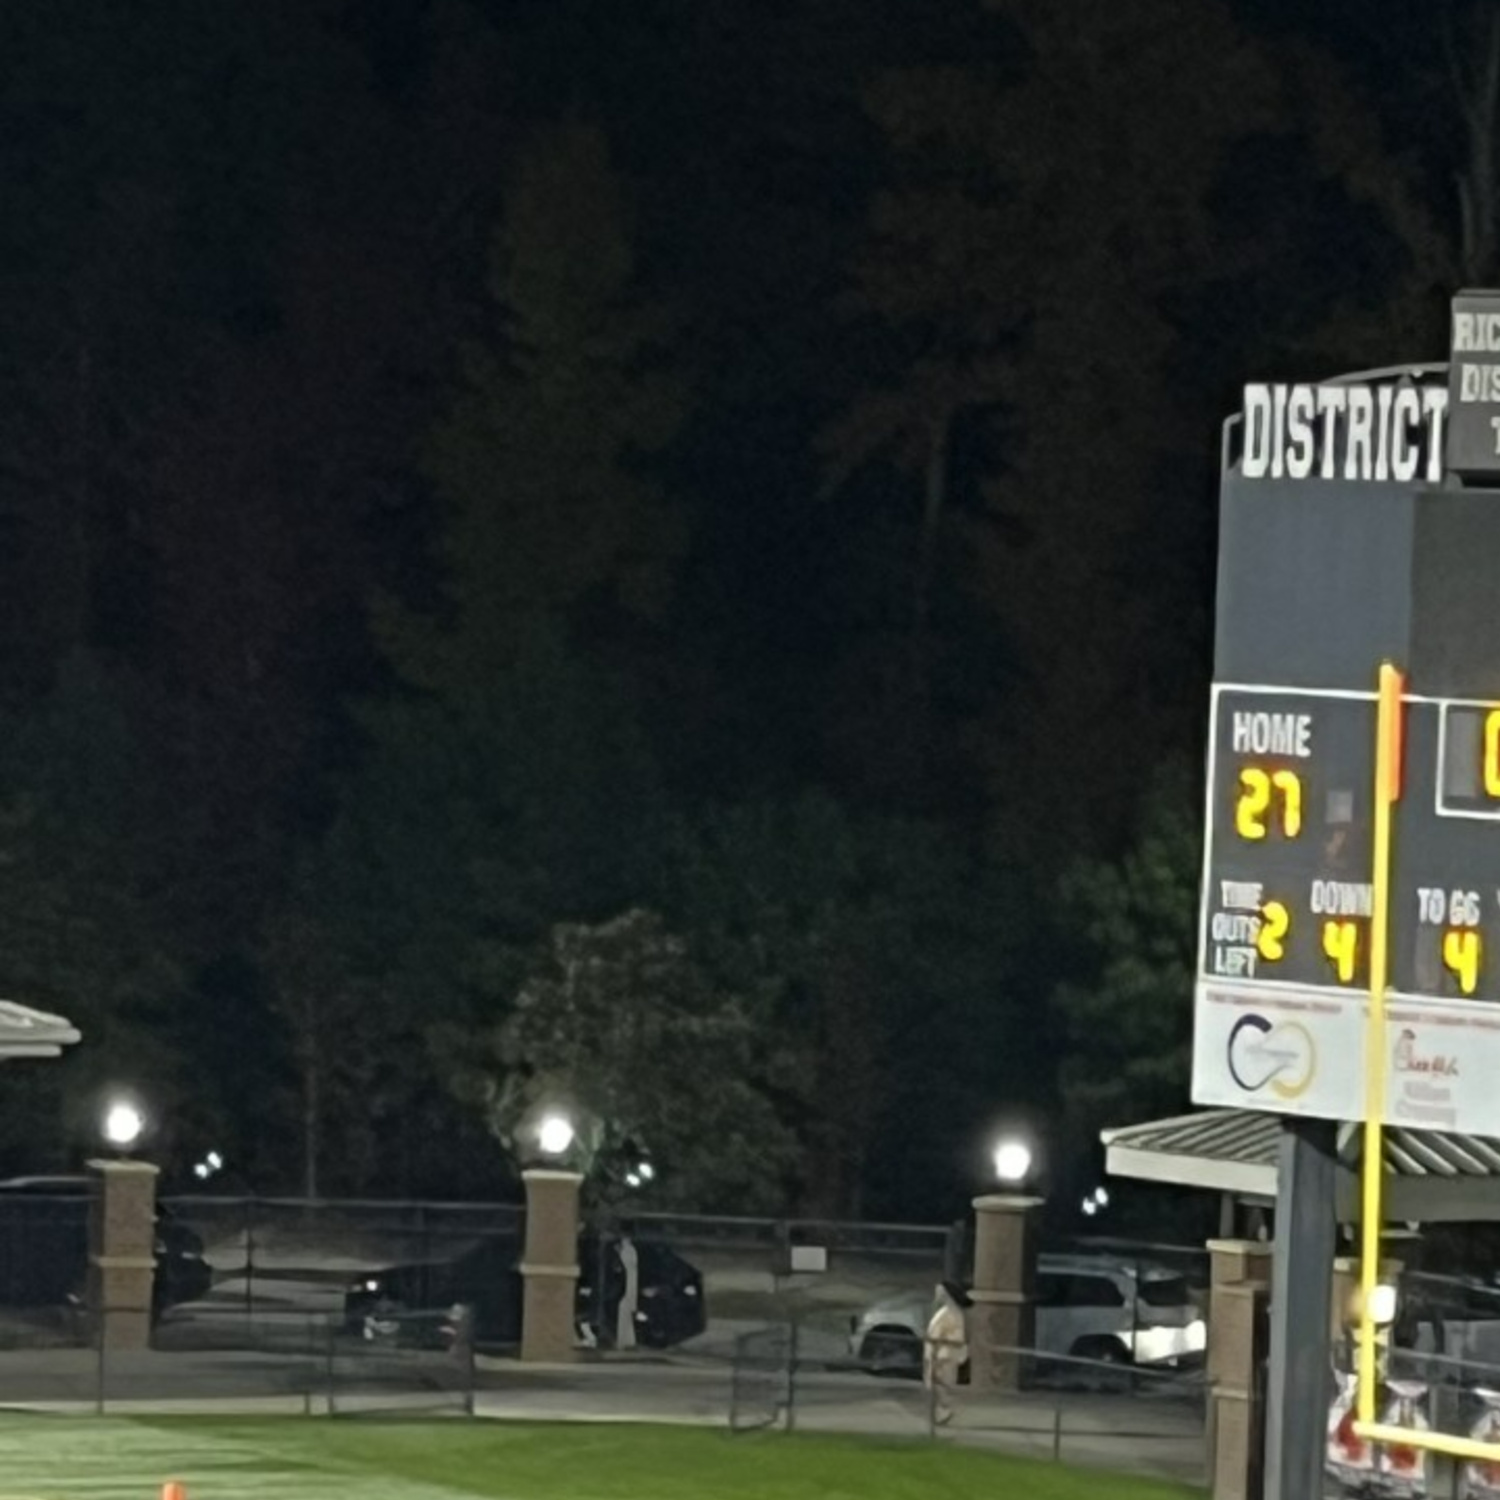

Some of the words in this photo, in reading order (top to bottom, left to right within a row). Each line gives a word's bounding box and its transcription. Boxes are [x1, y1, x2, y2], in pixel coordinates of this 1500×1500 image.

[1242, 383, 1449, 482] DISTRICT
[1232, 711, 1312, 757] HOME
[1236, 768, 1301, 839] 27
[1258, 901, 1289, 960] 2
[1417, 887, 1446, 925] TO
[1323, 920, 1357, 982] 4
[1444, 931, 1479, 994] 4
